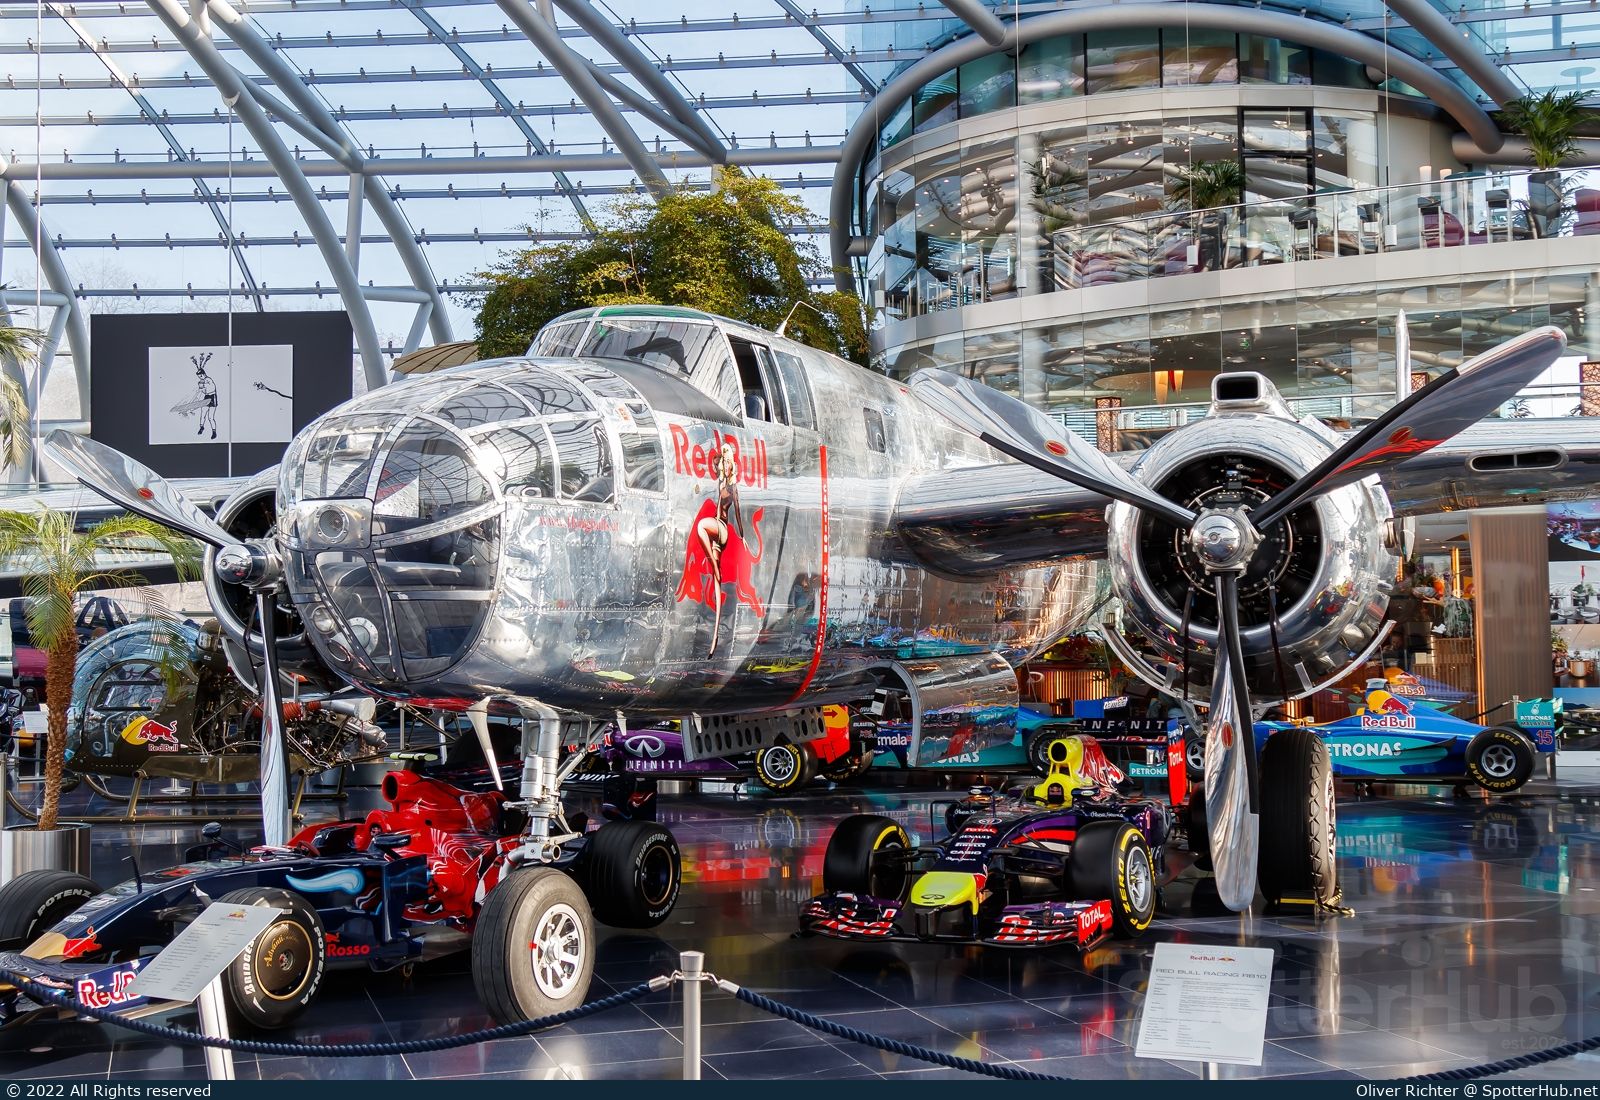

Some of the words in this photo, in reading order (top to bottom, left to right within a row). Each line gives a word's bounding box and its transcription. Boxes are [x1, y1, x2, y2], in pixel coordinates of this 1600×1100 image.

[816, 564, 829, 653] PROPELLER
[1081, 720, 1165, 730] INFNIT
[1494, 732, 1521, 746] EAGLE
[1536, 729, 1554, 745] 15
[1326, 742, 1402, 757] ETRONAS
[625, 759, 683, 770] INFINITI
[1131, 767, 1168, 776] PETRONA
[1469, 762, 1517, 788] GOODYEAR
[964, 827, 997, 835] TOTAL
[635, 833, 668, 868] BRIDGESTONE
[1118, 857, 1131, 914] ZERO
[37, 888, 92, 917] POTENZ
[1080, 906, 1105, 930] TOTAL
[327, 943, 371, 957] Rosso
[242, 939, 256, 995] BRIDGES
[300, 926, 325, 1005] POTENZA
